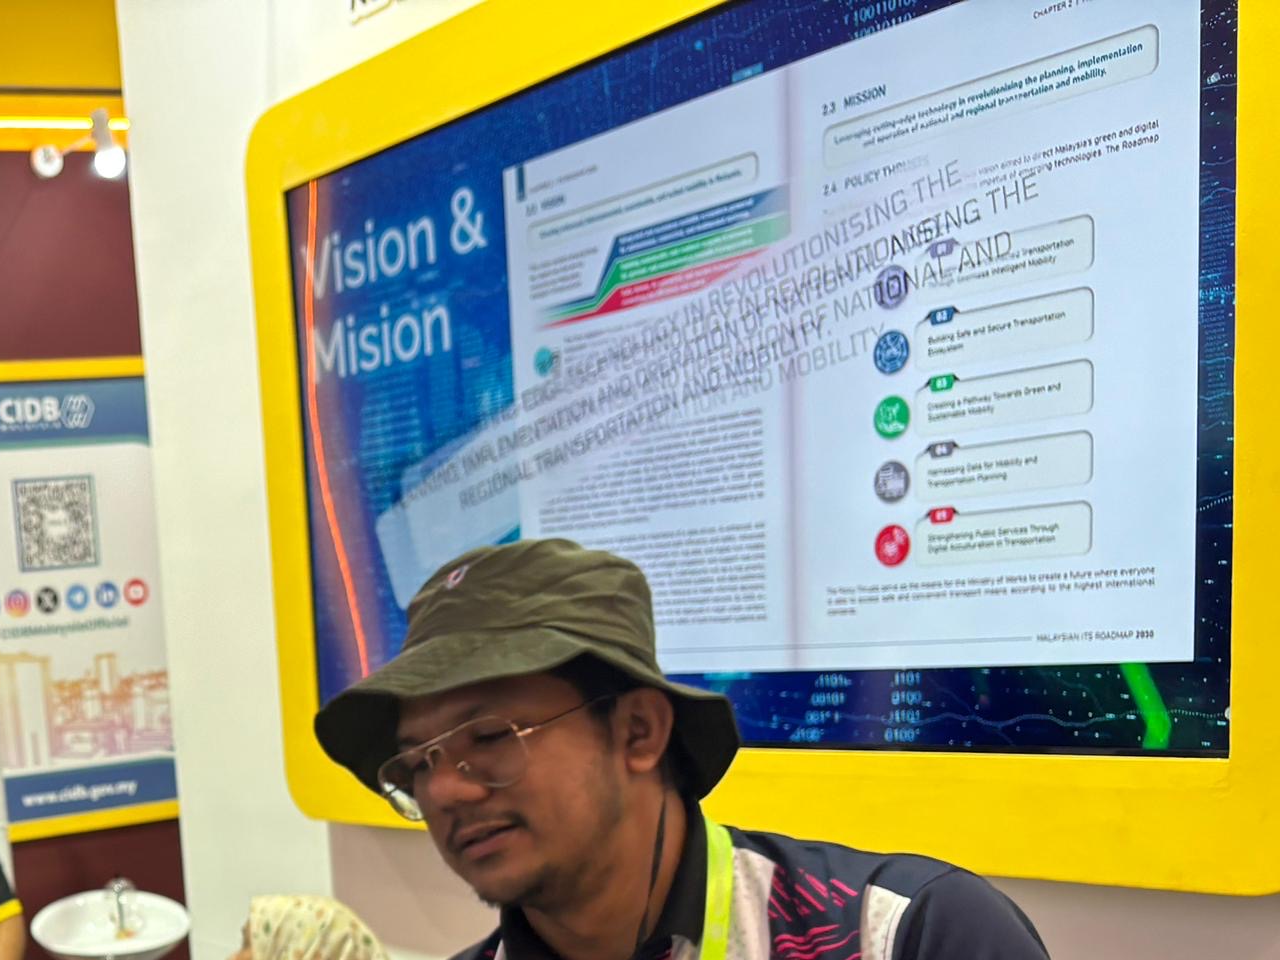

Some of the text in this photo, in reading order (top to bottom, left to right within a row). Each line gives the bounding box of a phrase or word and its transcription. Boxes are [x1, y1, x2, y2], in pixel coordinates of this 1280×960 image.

[843, 84, 887, 110] MISSION
[917, 102, 958, 124] technology
[1024, 75, 1039, 89] the
[1077, 42, 1144, 71] implementation
[950, 110, 965, 123] and
[965, 100, 997, 118] regional
[998, 84, 1054, 111] transportation
[1055, 77, 1071, 91] and
[1071, 66, 1107, 87] mobility.
[1093, 132, 1118, 147] green
[1118, 125, 1134, 139] and
[1133, 118, 1160, 134] digital
[1104, 141, 1121, 155] The
[1121, 132, 1160, 150] Roadmap
[843, 169, 881, 191] POLICY
[985, 172, 1040, 215] THE
[300, 216, 437, 300] Vision
[449, 186, 489, 255] &
[957, 230, 1012, 274] AND
[310, 303, 453, 384] Mision
[972, 324, 986, 337] and
[778, 322, 886, 385] MOBILITY
[1119, 565, 1156, 579] everyone
[21, 779, 139, 808] www.cidb.gov.my
